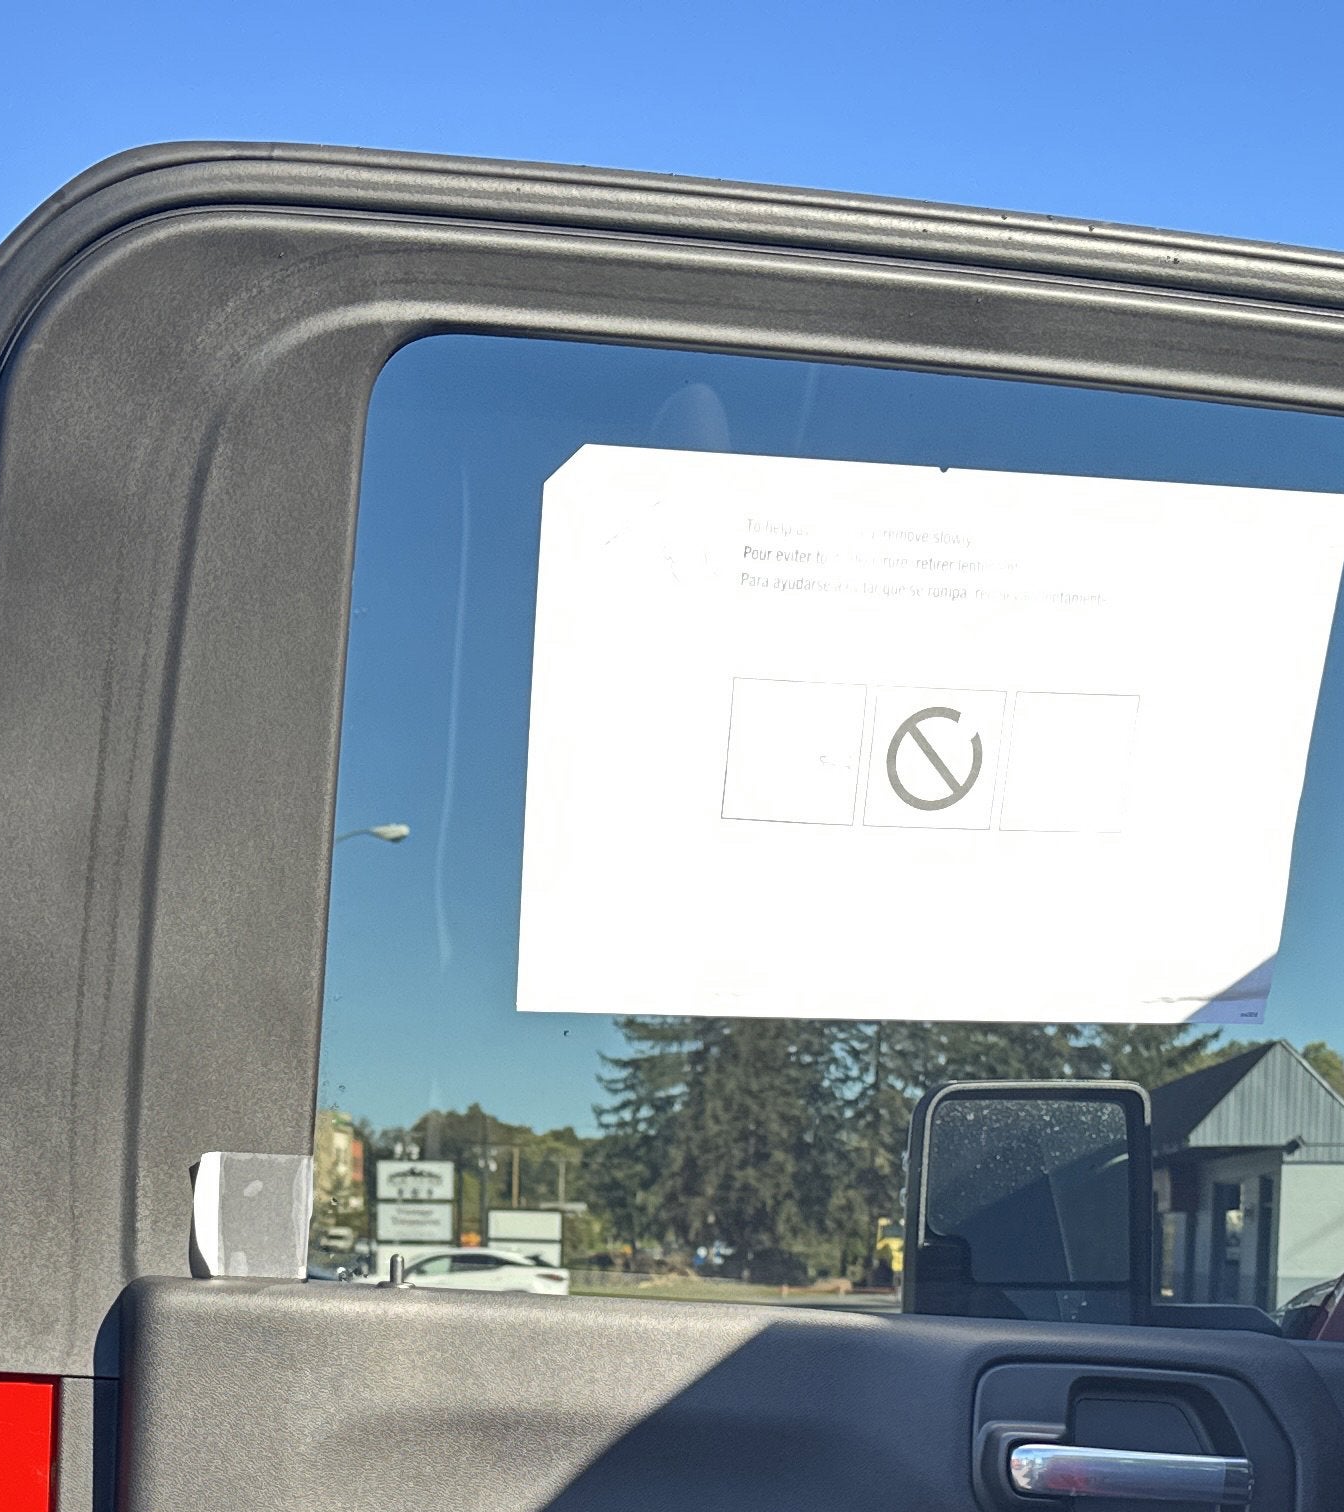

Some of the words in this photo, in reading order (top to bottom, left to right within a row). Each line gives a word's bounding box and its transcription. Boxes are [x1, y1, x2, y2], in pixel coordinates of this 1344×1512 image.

[743, 545, 773, 561] Pour
[916, 557, 955, 572] retirer
[740, 572, 769, 588] Para
